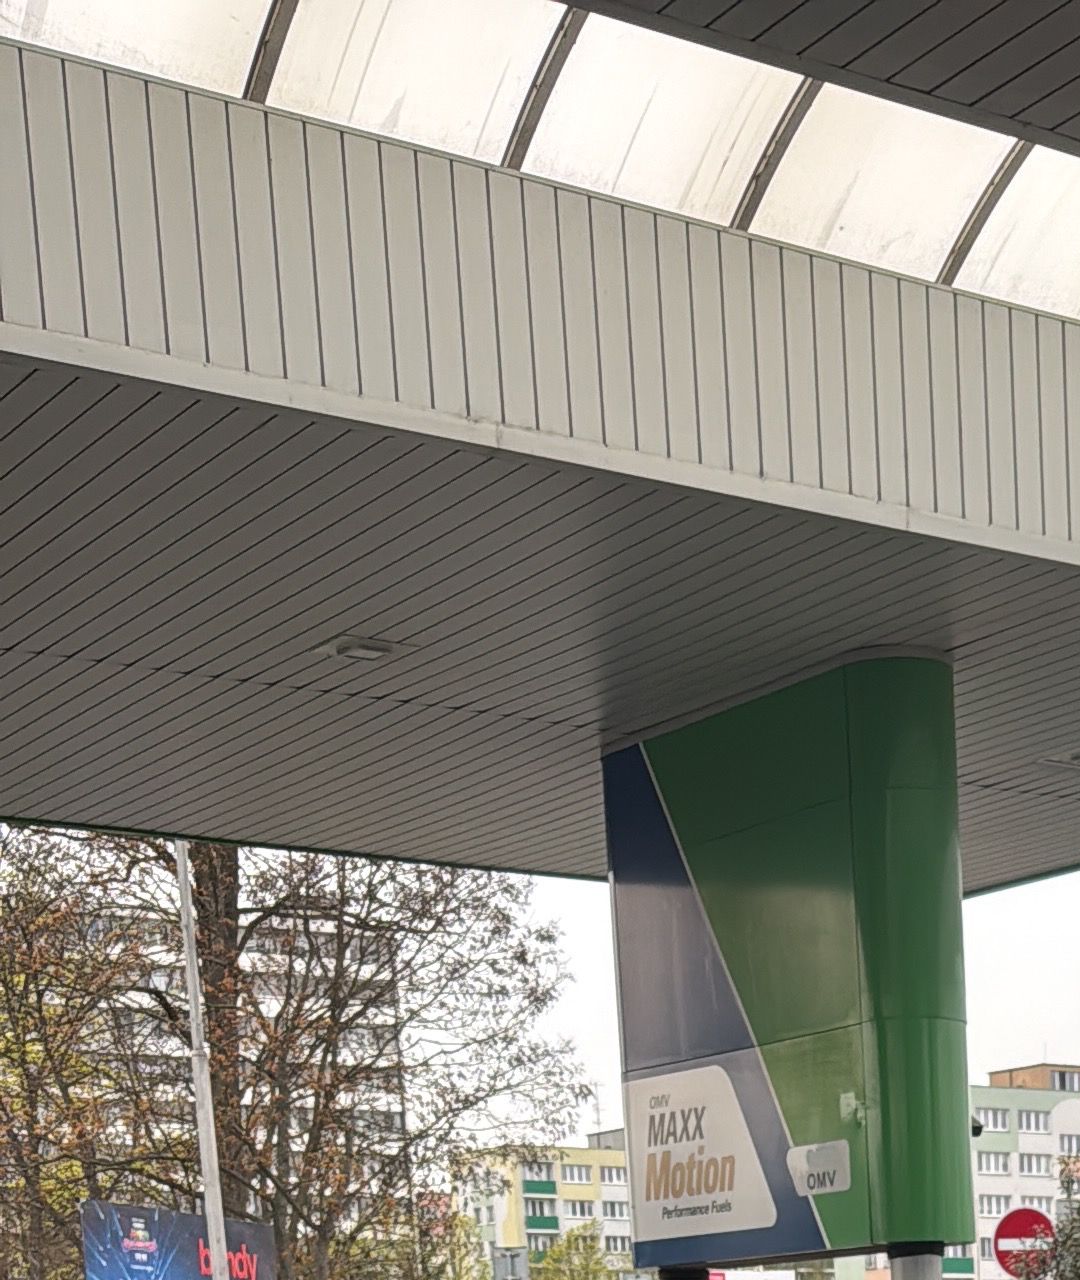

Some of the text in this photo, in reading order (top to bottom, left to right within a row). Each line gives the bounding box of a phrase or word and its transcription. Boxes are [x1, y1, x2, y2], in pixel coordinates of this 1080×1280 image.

[649, 1094, 670, 1109] OMV
[647, 1106, 706, 1147] MAXX
[645, 1144, 735, 1202] Motion
[806, 1170, 836, 1190] OMV
[662, 1200, 732, 1220] Performance Fuels
